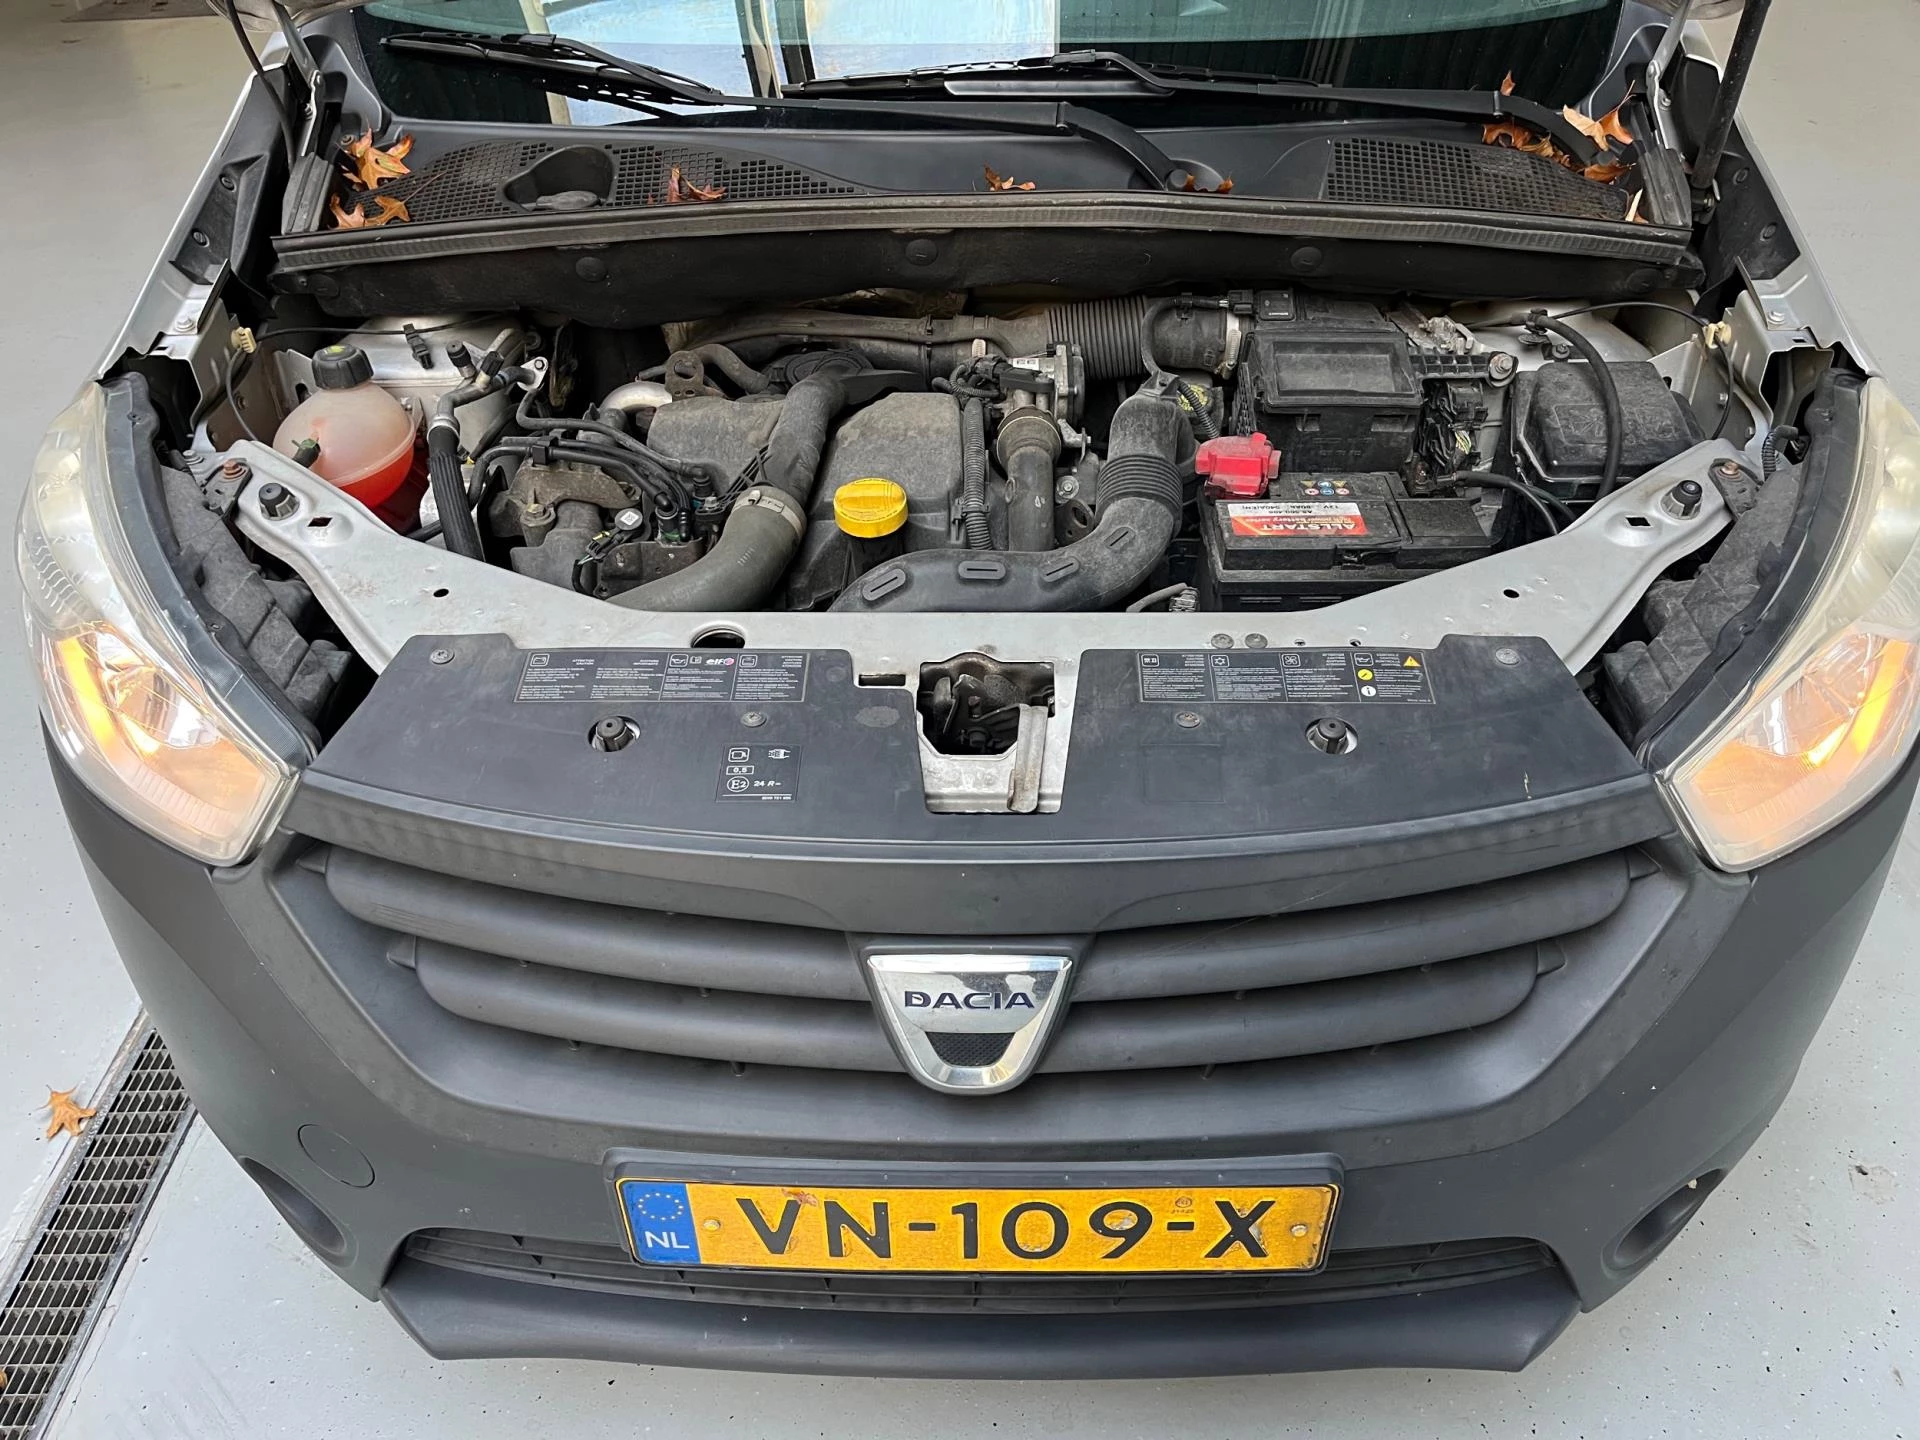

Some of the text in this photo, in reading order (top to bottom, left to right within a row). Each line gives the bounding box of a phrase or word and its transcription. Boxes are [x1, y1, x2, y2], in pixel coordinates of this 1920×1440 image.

[1260, 522, 1356, 531] ALLSTART
[730, 779, 747, 789] E2
[904, 990, 1035, 1010] DACIA
[736, 1197, 1276, 1261] VN-109-X
[645, 1230, 690, 1250] NL
